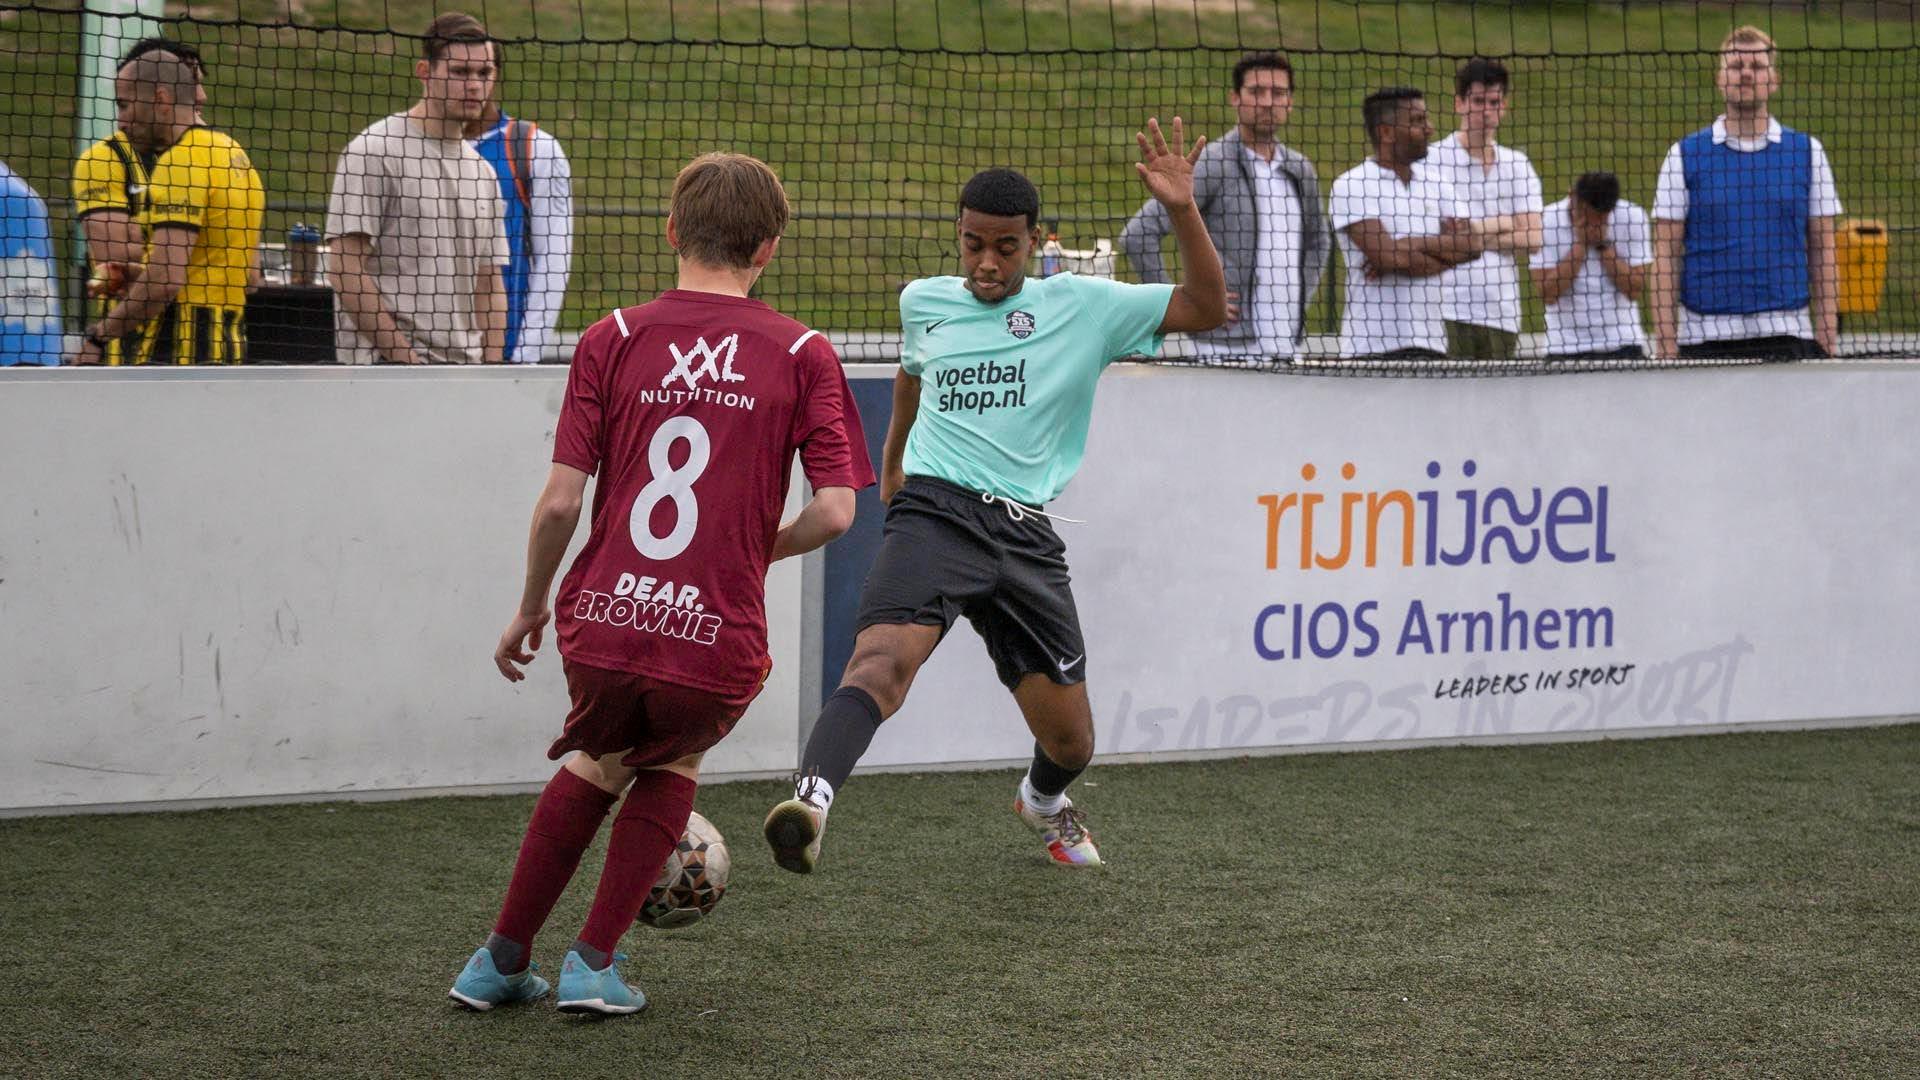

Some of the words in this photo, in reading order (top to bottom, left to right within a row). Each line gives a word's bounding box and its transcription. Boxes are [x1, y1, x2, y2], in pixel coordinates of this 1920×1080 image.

[662, 334, 745, 390] XXL
[936, 359, 1026, 388] voetbal
[938, 384, 1026, 415] shop.nl
[630, 416, 711, 560] 8
[614, 573, 704, 611] DEAR.
[574, 591, 722, 645] BROWNIE
[1254, 600, 1380, 661] CIOS
[1396, 592, 1614, 655] Arnhem
[1435, 673, 1529, 699] LEADERS
[1536, 671, 1562, 691] IN
[1567, 664, 1635, 689] SPORT
